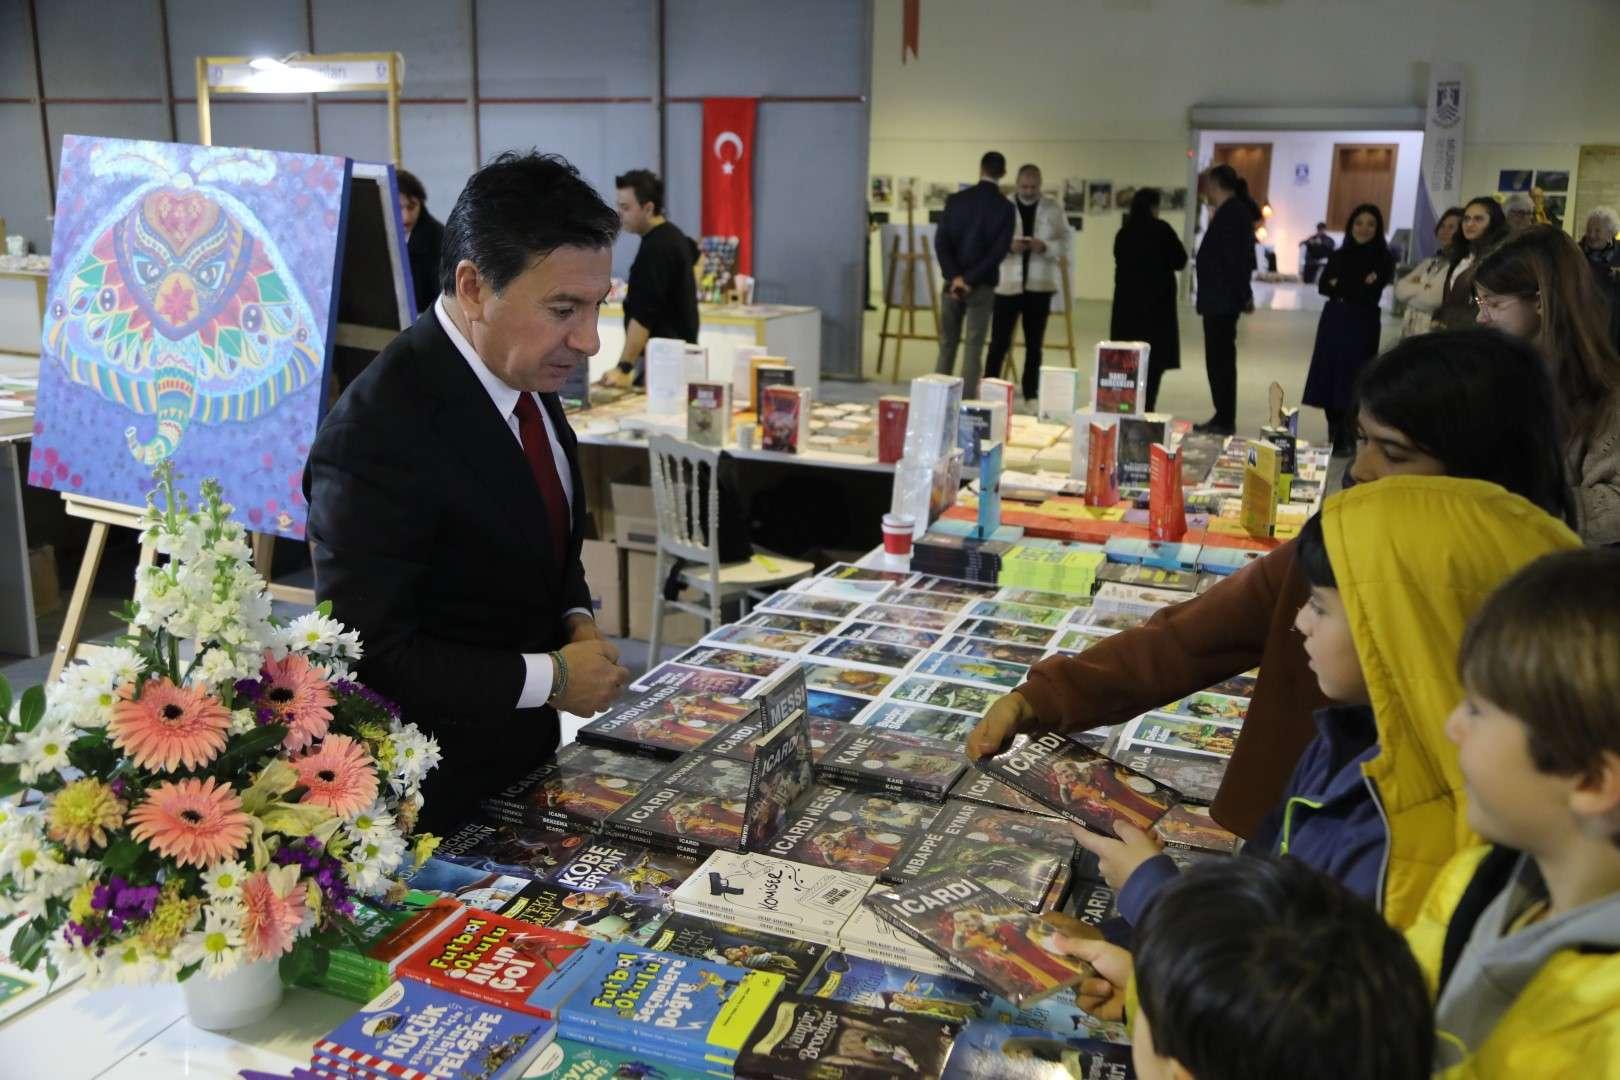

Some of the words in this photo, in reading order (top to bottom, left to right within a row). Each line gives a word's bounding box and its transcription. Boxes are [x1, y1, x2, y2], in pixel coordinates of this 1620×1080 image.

[596, 707, 642, 733] ICARDI
[635, 685, 677, 711] ICARDI
[770, 684, 806, 728] MESSI
[713, 725, 758, 753] ICARDI
[761, 735, 800, 777] ICARDI
[835, 738, 875, 765] KANE
[1001, 732, 1066, 776] ICARDI
[626, 787, 680, 824] ICARDI
[770, 816, 820, 855] ICARDI
[805, 784, 847, 816] MESSI
[944, 804, 978, 835] EYMAR
[558, 845, 609, 887] KOBE
[580, 849, 627, 891] BRYANT
[902, 833, 944, 876] MBAPPÉ
[891, 877, 982, 919] ICARDI
[1080, 886, 1114, 927] CARDI
[430, 919, 487, 969] Futbol
[454, 927, 507, 969] Okulu
[488, 958, 536, 990] Gol
[592, 953, 639, 1009] Futbol
[613, 961, 662, 1010] Okulu
[633, 959, 687, 1023] Seçmelere
[654, 982, 694, 1028] Doğru
[382, 1003, 448, 1059] KÜÇÜK
[431, 1012, 503, 1078] FELSEFE
